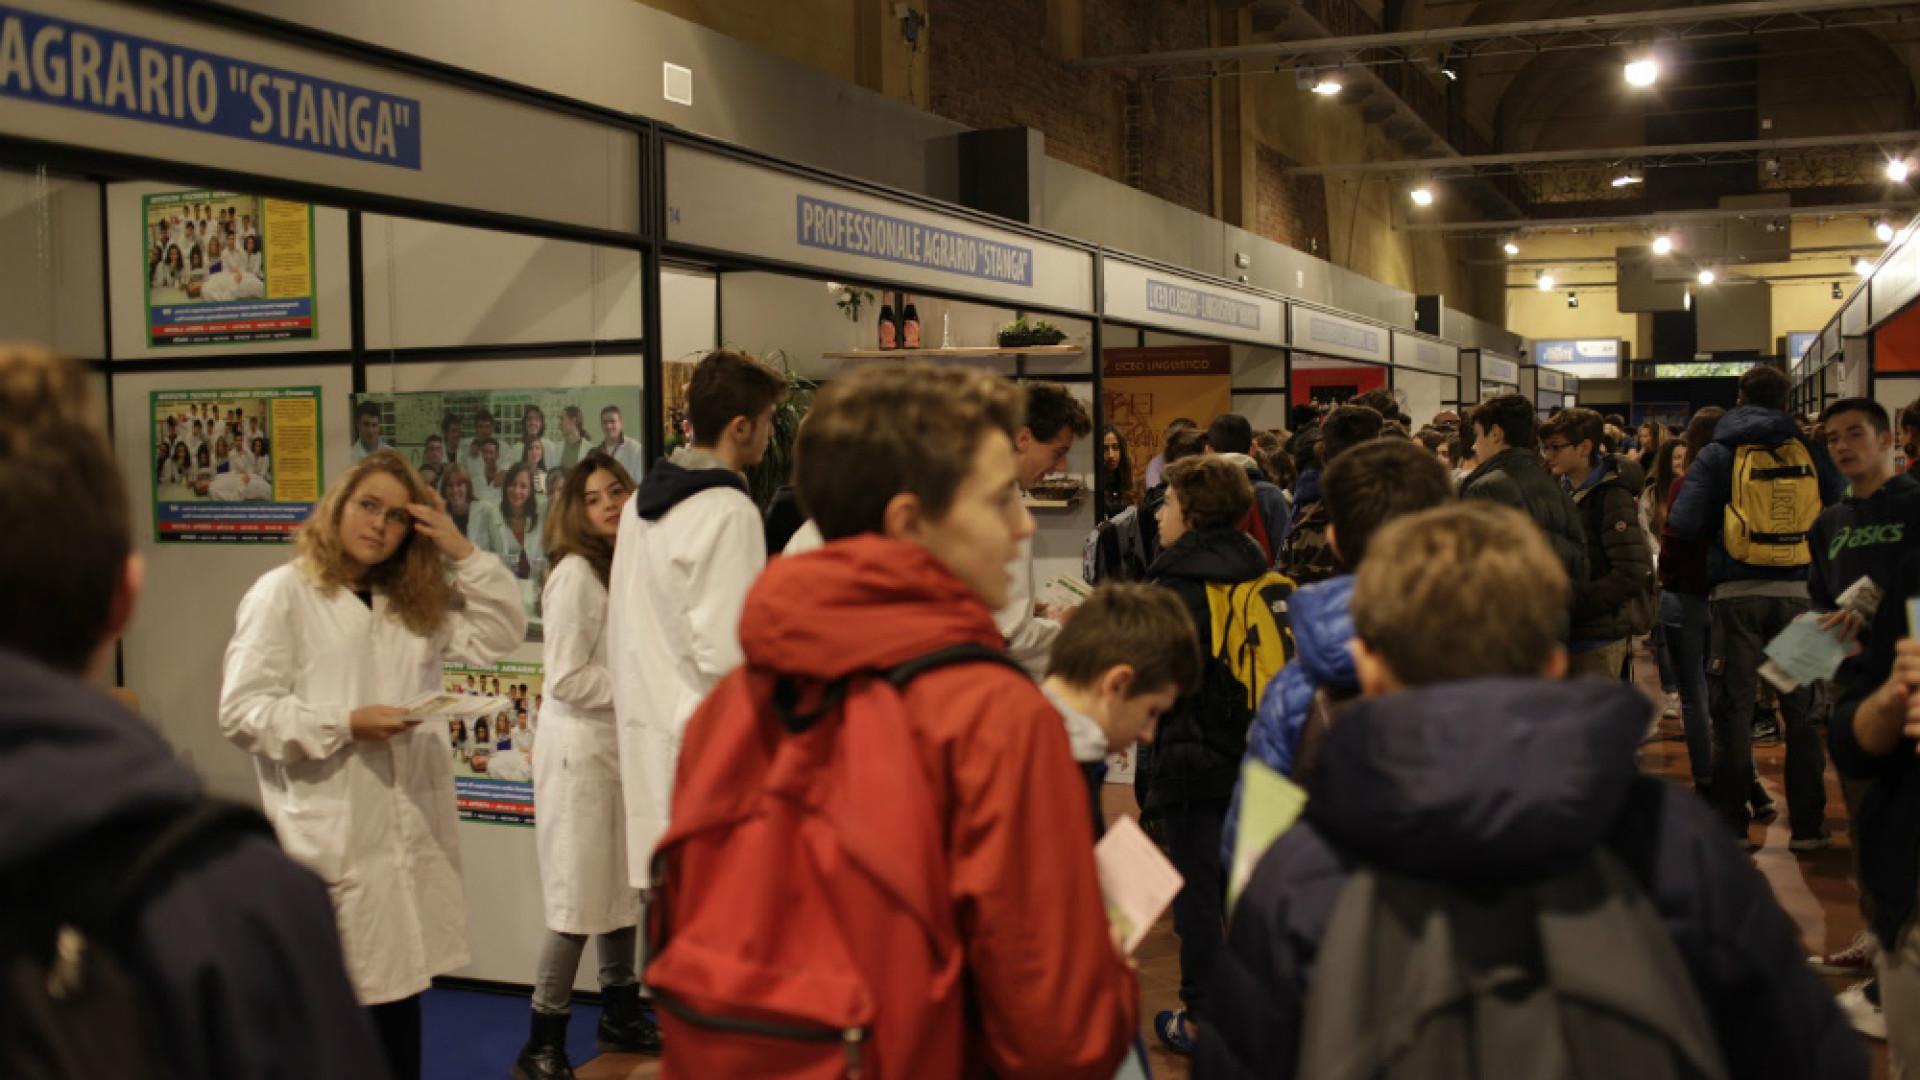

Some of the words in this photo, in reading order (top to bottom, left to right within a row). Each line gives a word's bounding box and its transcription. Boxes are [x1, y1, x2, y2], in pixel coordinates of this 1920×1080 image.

[0, 17, 217, 123] AGRARIO
[229, 66, 411, 159] "STANGA"
[802, 202, 921, 262] PROFESSIONALE
[923, 229, 977, 273] AGRARIO
[979, 241, 1028, 282] "STANGA"
[1115, 361, 1145, 371] LICEO
[1147, 359, 1210, 371] LINGUISTICO
